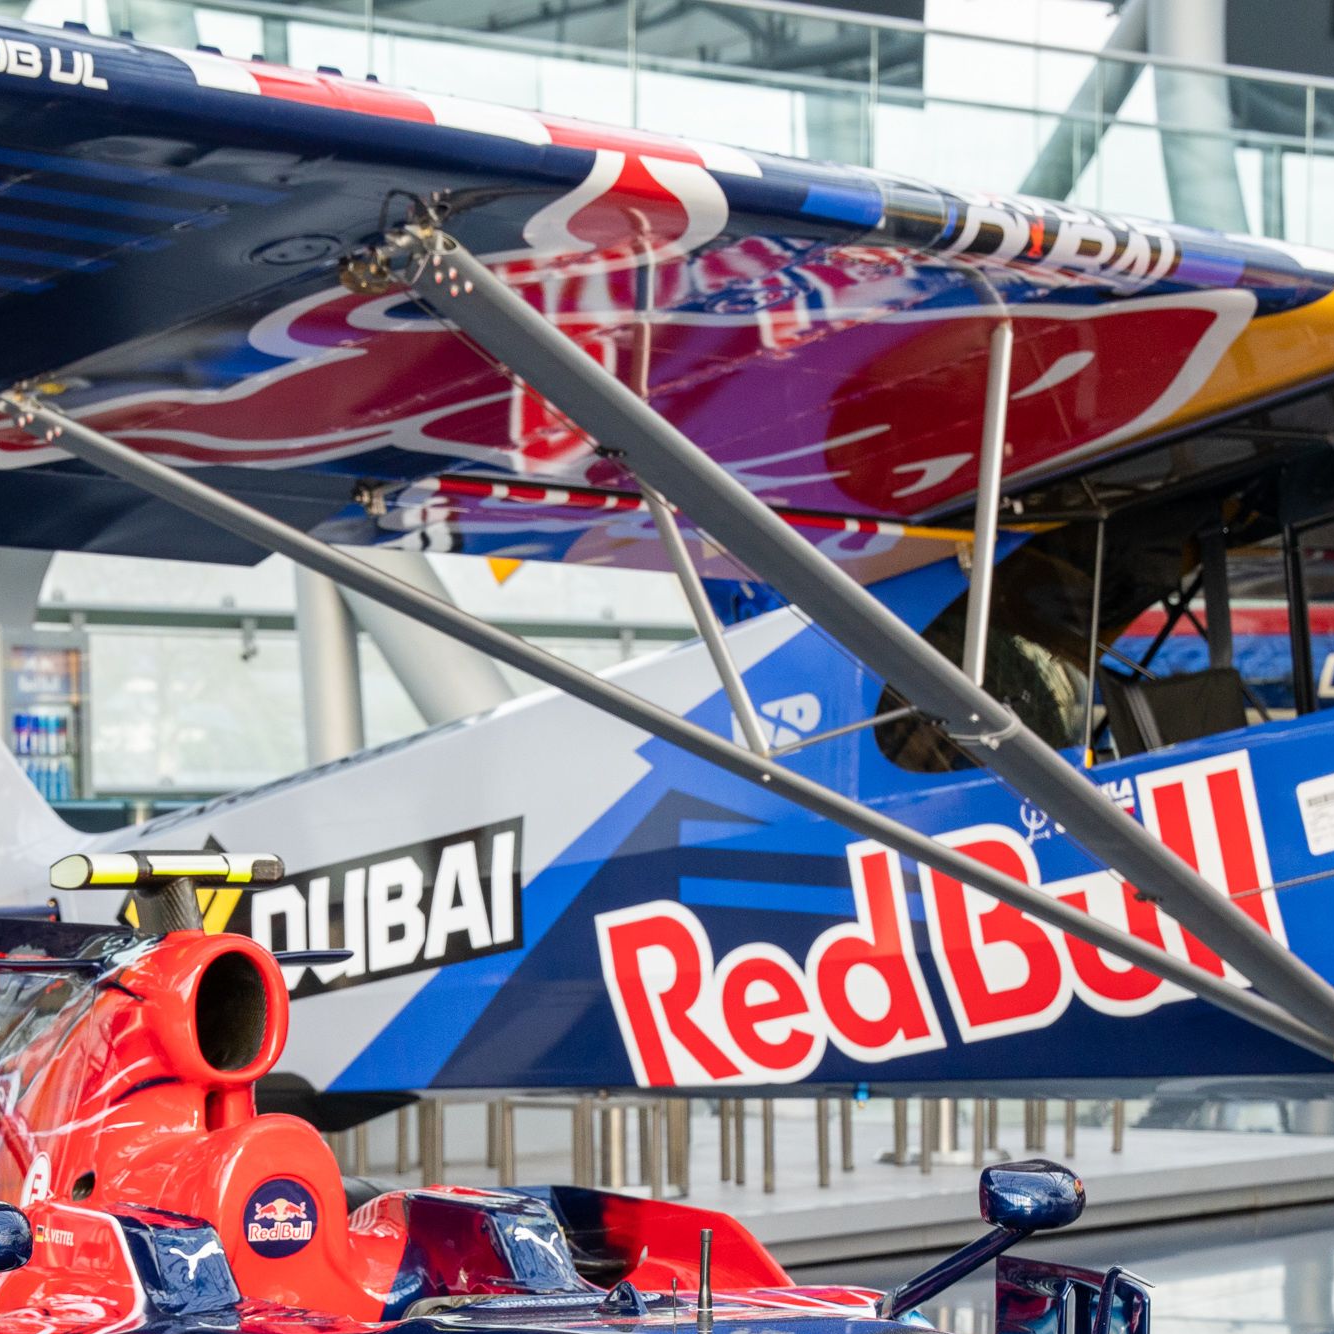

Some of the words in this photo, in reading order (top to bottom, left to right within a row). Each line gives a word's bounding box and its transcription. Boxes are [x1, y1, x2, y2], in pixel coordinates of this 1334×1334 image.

[49, 46, 109, 91] UL
[250, 831, 516, 990] DUBAI
[593, 836, 947, 1087] Red
[916, 748, 1290, 1043] Bull
[248, 1221, 280, 1242] Red
[280, 1220, 313, 1241] Bull
